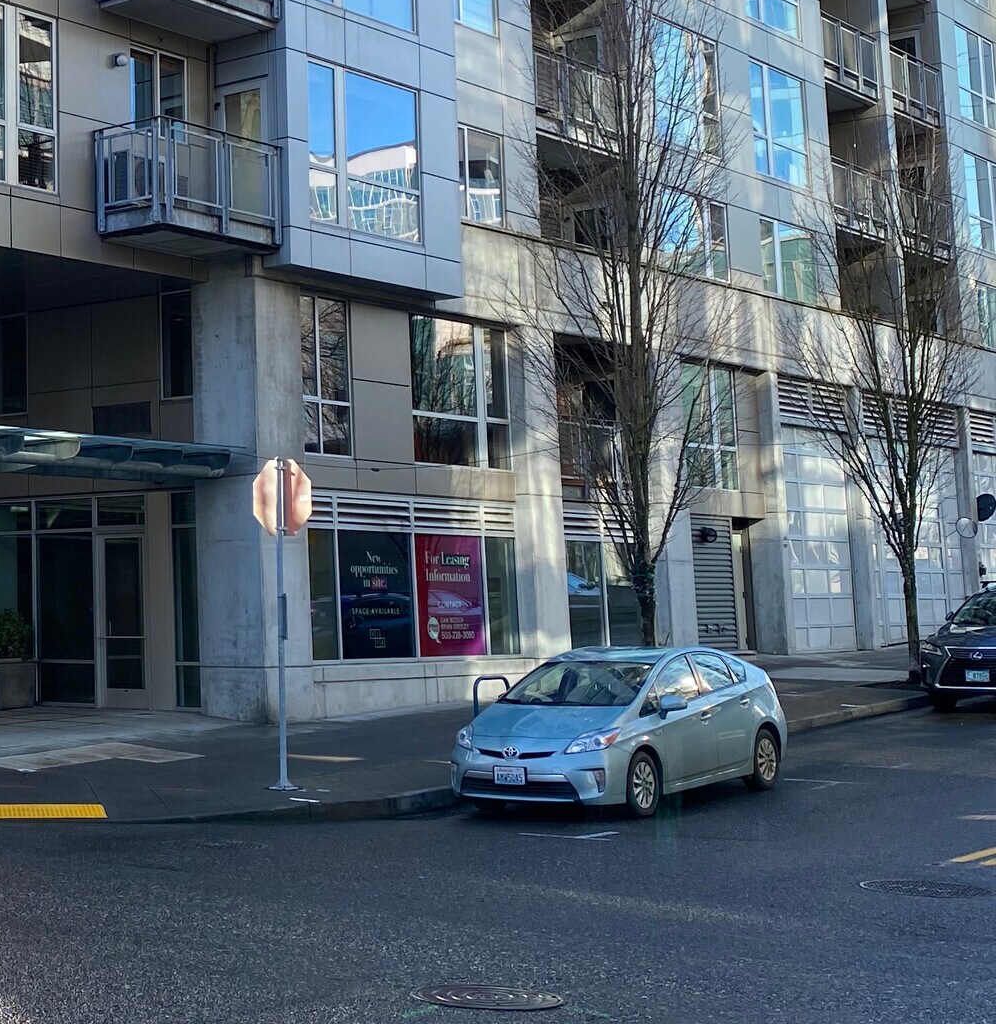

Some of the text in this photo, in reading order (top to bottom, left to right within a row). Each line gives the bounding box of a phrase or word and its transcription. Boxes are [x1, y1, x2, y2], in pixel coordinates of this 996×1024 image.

[366, 550, 382, 563] New
[425, 550, 470, 570] For Leasing
[350, 562, 399, 578] opportunities
[425, 568, 471, 583] Information
[363, 575, 371, 588] in
[351, 607, 400, 615] SPACE AVAILABLE
